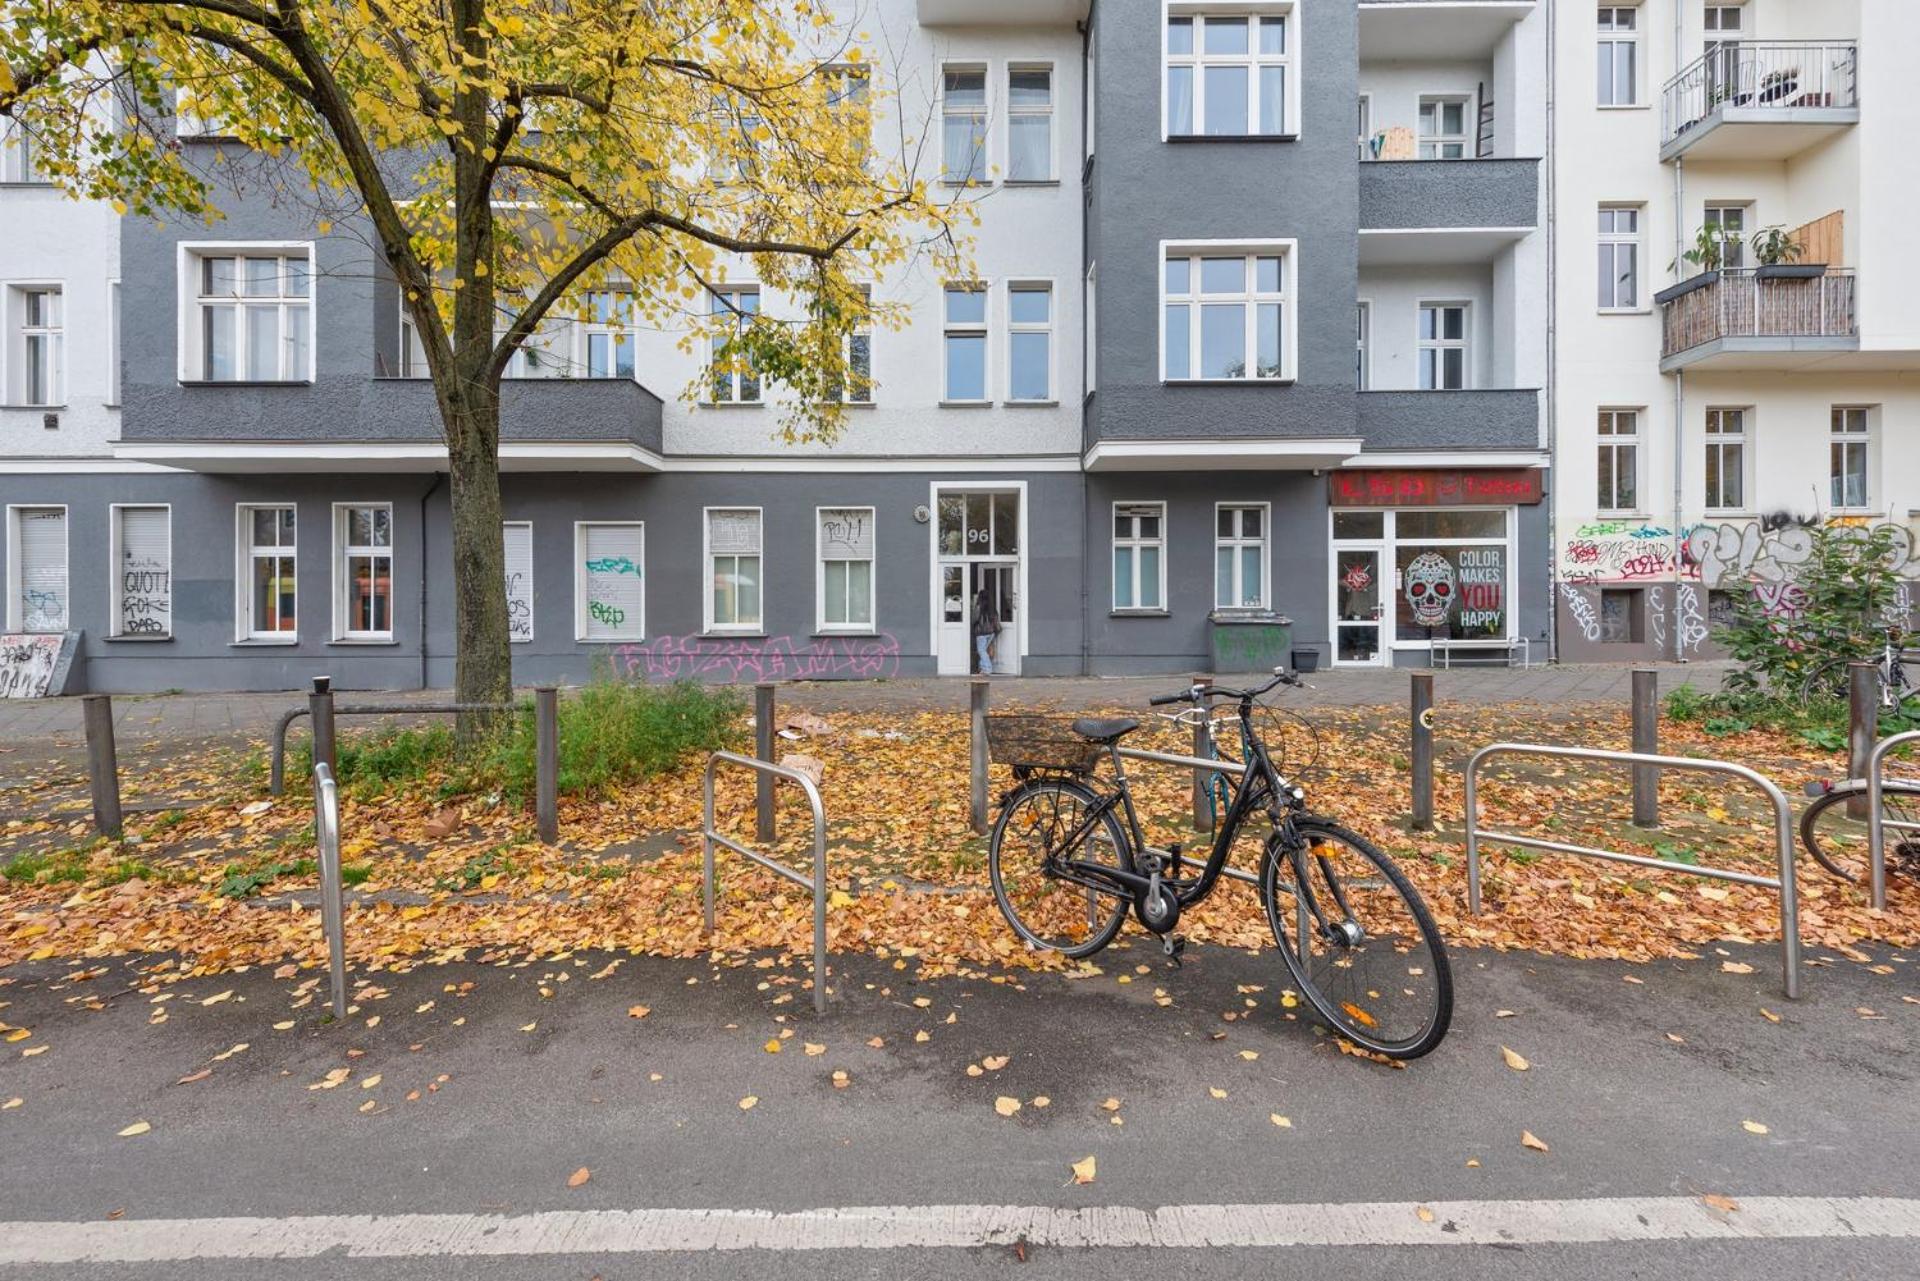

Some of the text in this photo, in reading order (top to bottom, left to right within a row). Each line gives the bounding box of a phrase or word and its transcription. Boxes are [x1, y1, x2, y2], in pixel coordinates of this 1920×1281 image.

[968, 528, 989, 543] 96
[1459, 551, 1500, 567] COLOR
[1459, 568, 1500, 583] MAKES
[1460, 584, 1500, 610] YOU
[1461, 611, 1500, 627] HAPPY
